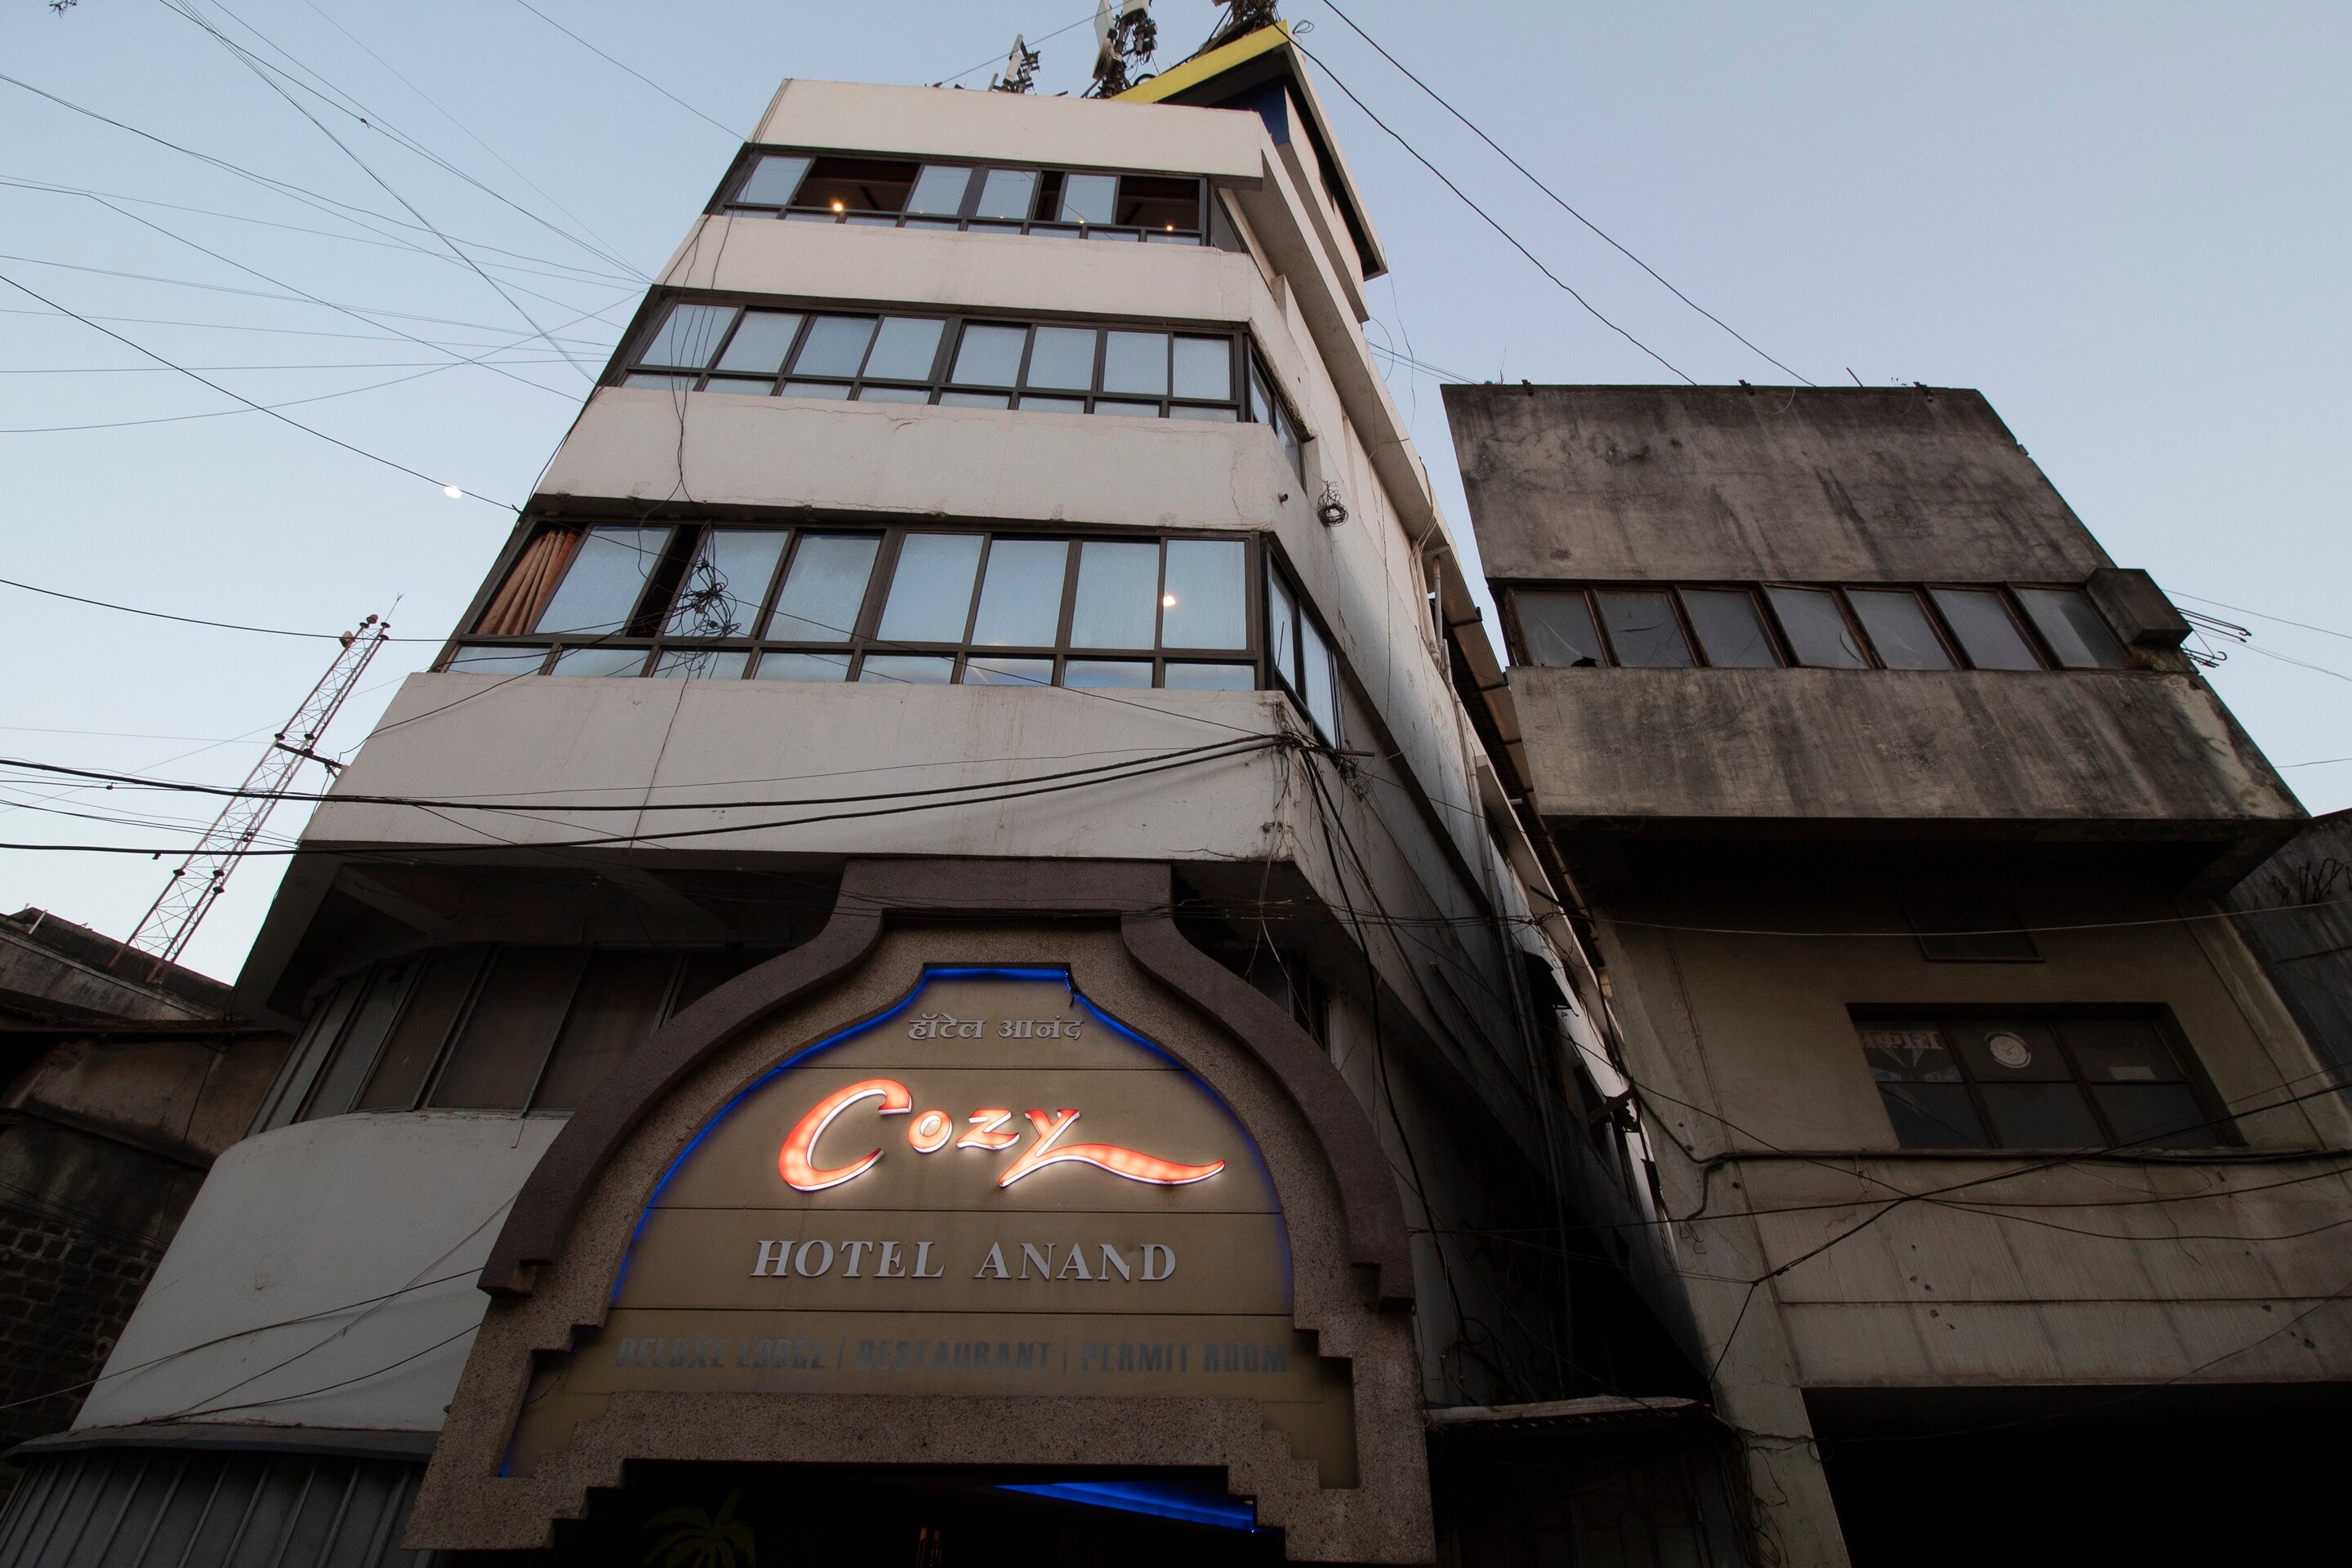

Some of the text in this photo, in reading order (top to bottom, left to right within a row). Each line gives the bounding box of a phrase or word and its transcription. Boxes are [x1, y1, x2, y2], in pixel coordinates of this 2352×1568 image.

[908, 1012, 1085, 1041] हॉटेल आनंद
[778, 1078, 1225, 1192] Cozy
[751, 1239, 1177, 1282] HOTEL ANAND
[617, 1337, 726, 1369] DELUXE
[854, 1339, 1052, 1373] RESTAURANT
[1080, 1340, 1187, 1374] PERMIT
[1204, 1342, 1289, 1374] ROOM
